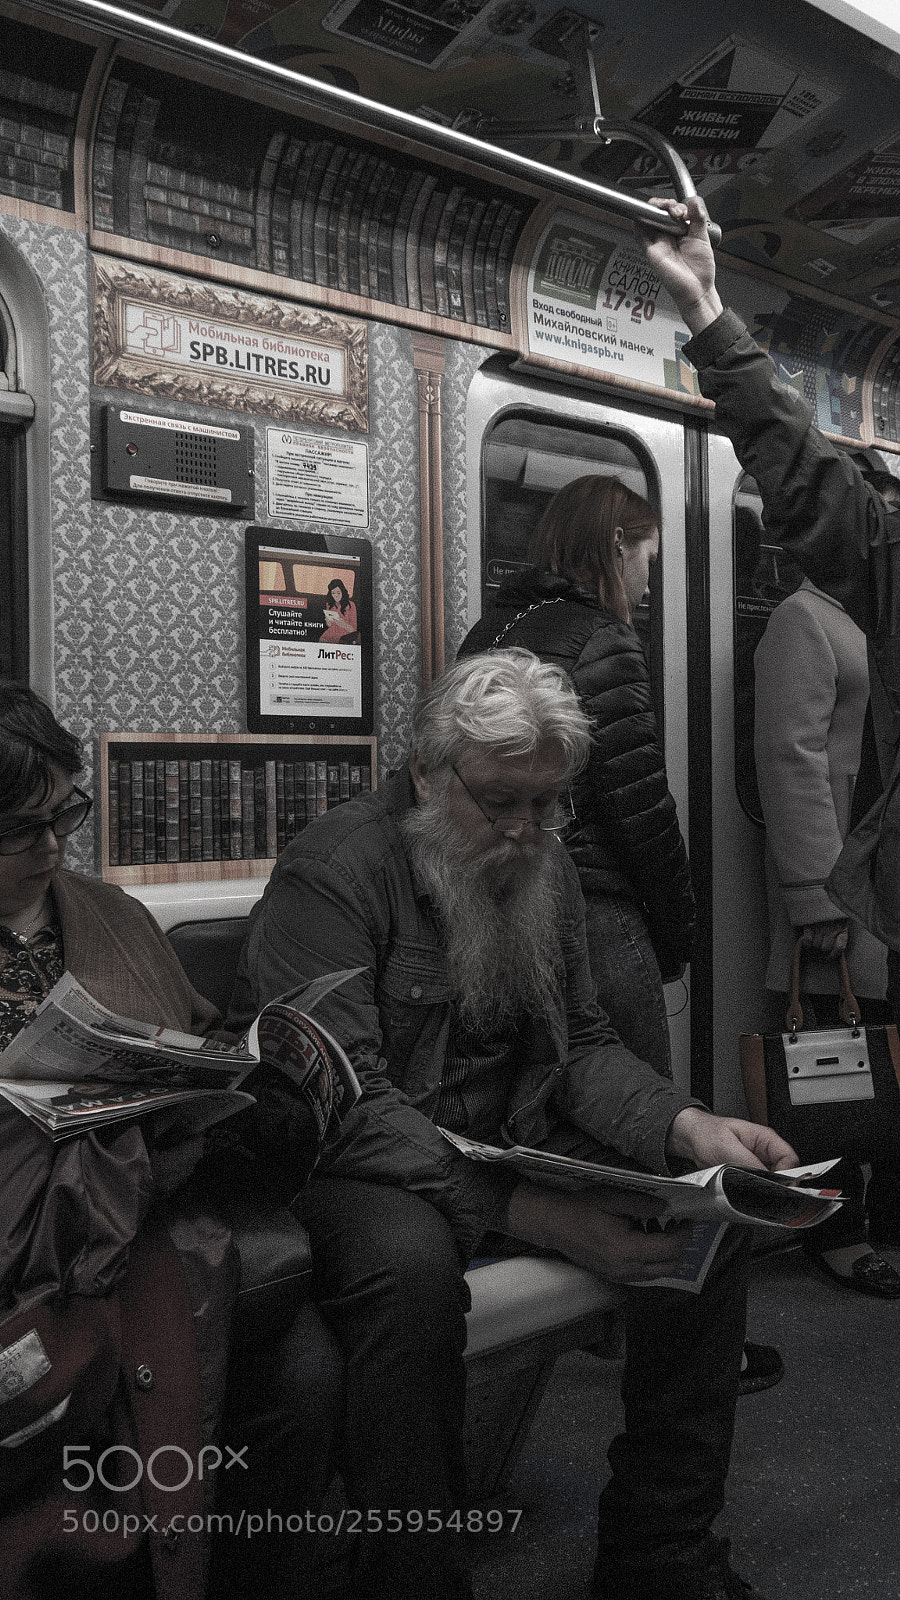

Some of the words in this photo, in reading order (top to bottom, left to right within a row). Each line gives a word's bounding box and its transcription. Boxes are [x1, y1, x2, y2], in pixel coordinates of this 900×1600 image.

[679, 109, 743, 125] ЖИВЫЕ
[671, 125, 741, 140] МИШЕНИ
[613, 259, 661, 283] КНИЖНЫ
[608, 271, 661, 299] САЛОН
[532, 299, 554, 315] Вход
[556, 307, 603, 327] свободный
[188, 320, 260, 348] Мобильная
[262, 338, 331, 363] библиотека
[533, 312, 617, 346] Михайловский
[620, 338, 655, 356] манеж
[535, 330, 624, 361] www.knigaspb.ru
[189, 340, 331, 386] SPB.LITRES.RU
[123, 411, 166, 427] Экстренная
[167, 420, 186, 430] связь
[193, 426, 238, 439] машинистом
[493, 566, 503, 575] Не
[268, 597, 305, 606] SPB.LITRES.RU
[268, 608, 302, 619] Слушайте
[268, 627, 307, 636] бесплатно!
[274, 619, 303, 627] читайте
[304, 621, 324, 629] книги
